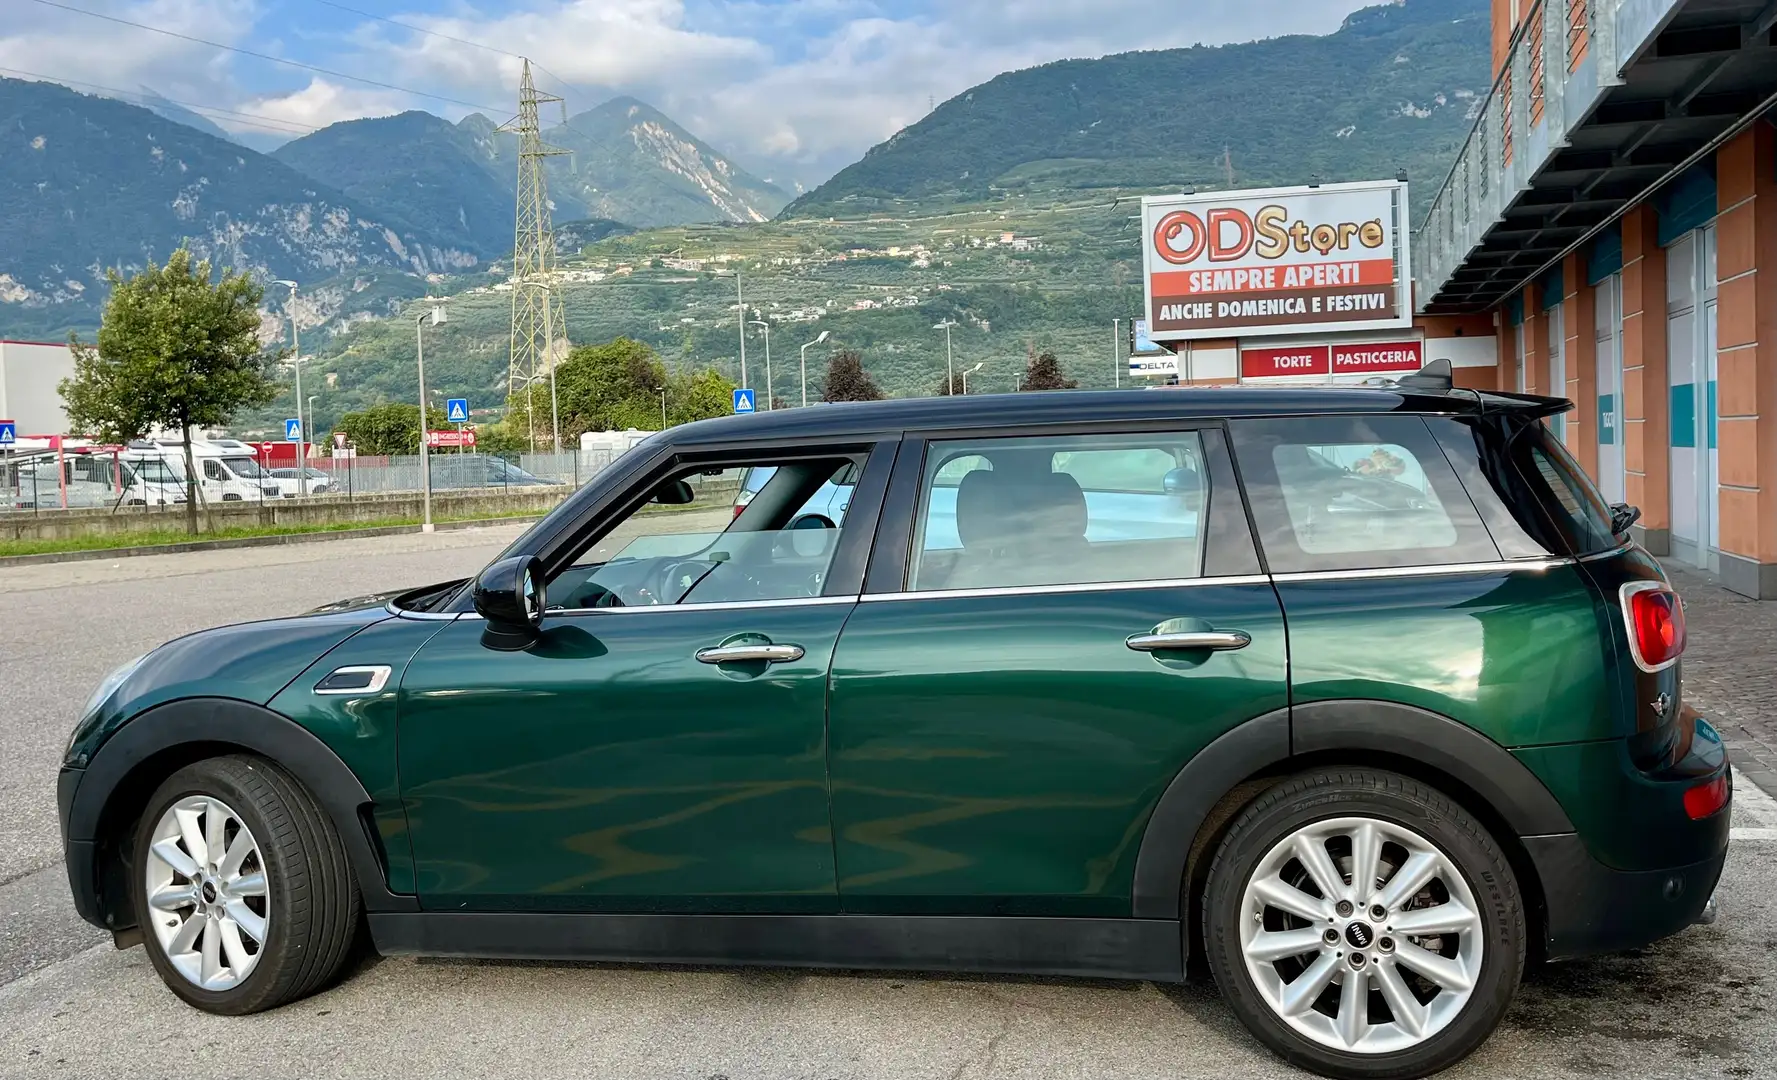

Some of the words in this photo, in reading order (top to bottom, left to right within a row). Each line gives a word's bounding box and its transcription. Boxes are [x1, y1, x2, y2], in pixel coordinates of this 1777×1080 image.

[1189, 267, 1276, 293] SEMPRE
[1283, 262, 1361, 288] APERTI
[1159, 301, 1213, 321] ANCHE
[1218, 296, 1307, 318] DOMENICA
[1312, 297, 1321, 313] E
[1327, 293, 1385, 312] FESTIVI
[1139, 362, 1175, 370] DELTA
[1273, 354, 1312, 369] TORTE
[1336, 350, 1417, 366] PASTICCERIA
[1481, 871, 1511, 947] WESTLAKE
[1351, 924, 1368, 945] MINI
